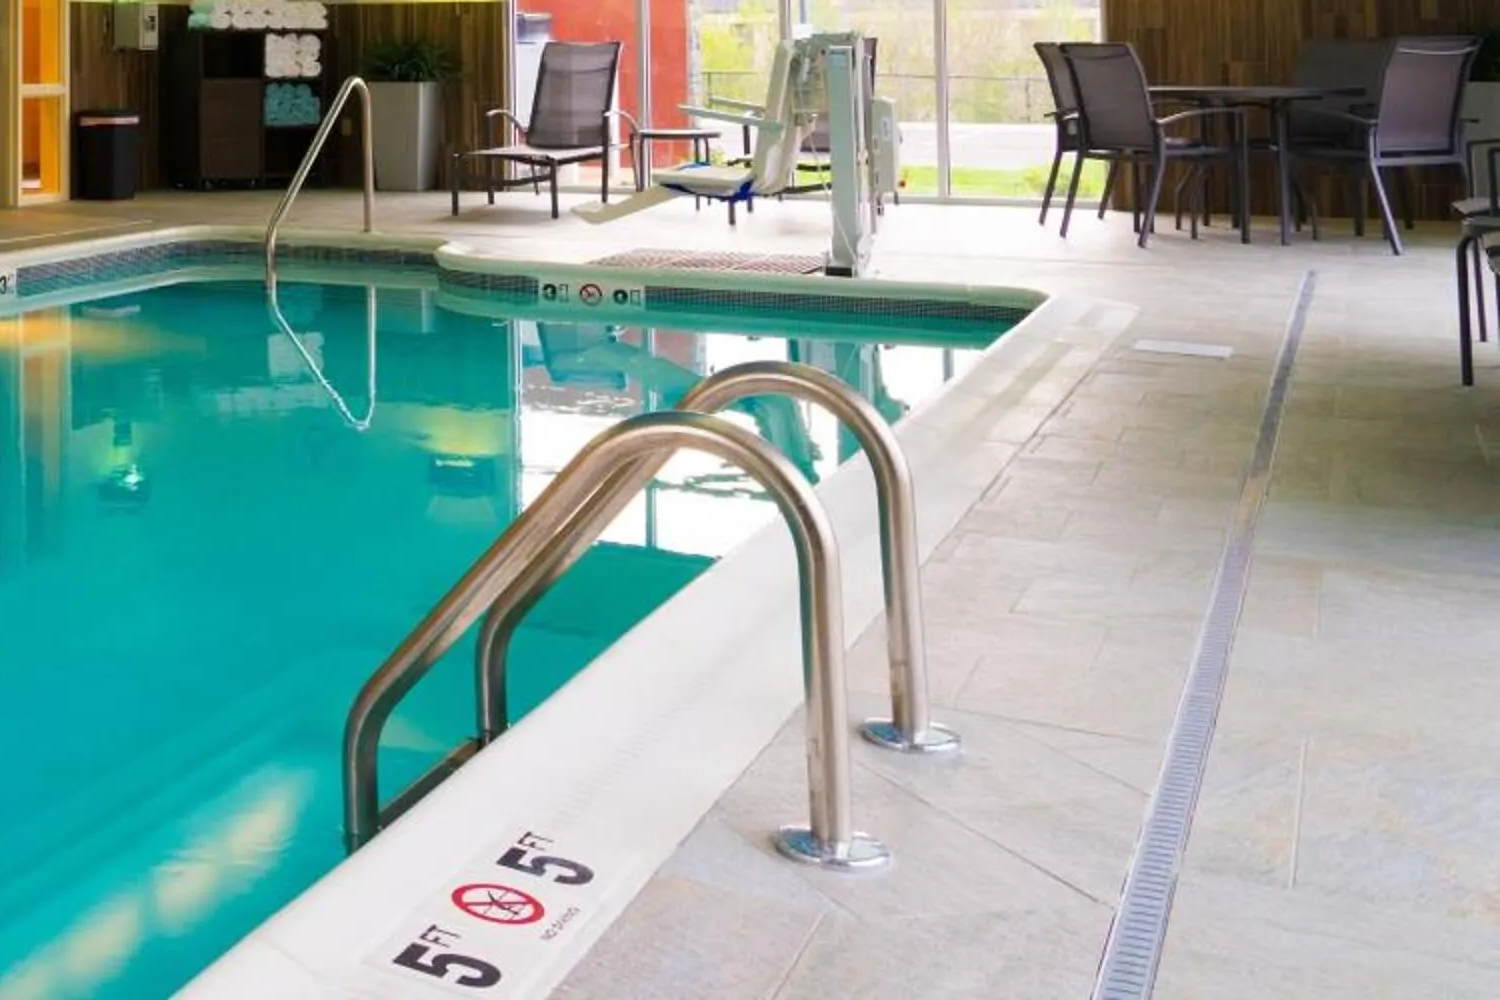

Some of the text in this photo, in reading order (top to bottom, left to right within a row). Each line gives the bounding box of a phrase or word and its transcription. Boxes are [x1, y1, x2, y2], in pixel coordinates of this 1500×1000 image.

[517, 831, 555, 851] FT
[496, 846, 595, 886] 5
[393, 924, 503, 989] 5 FT
